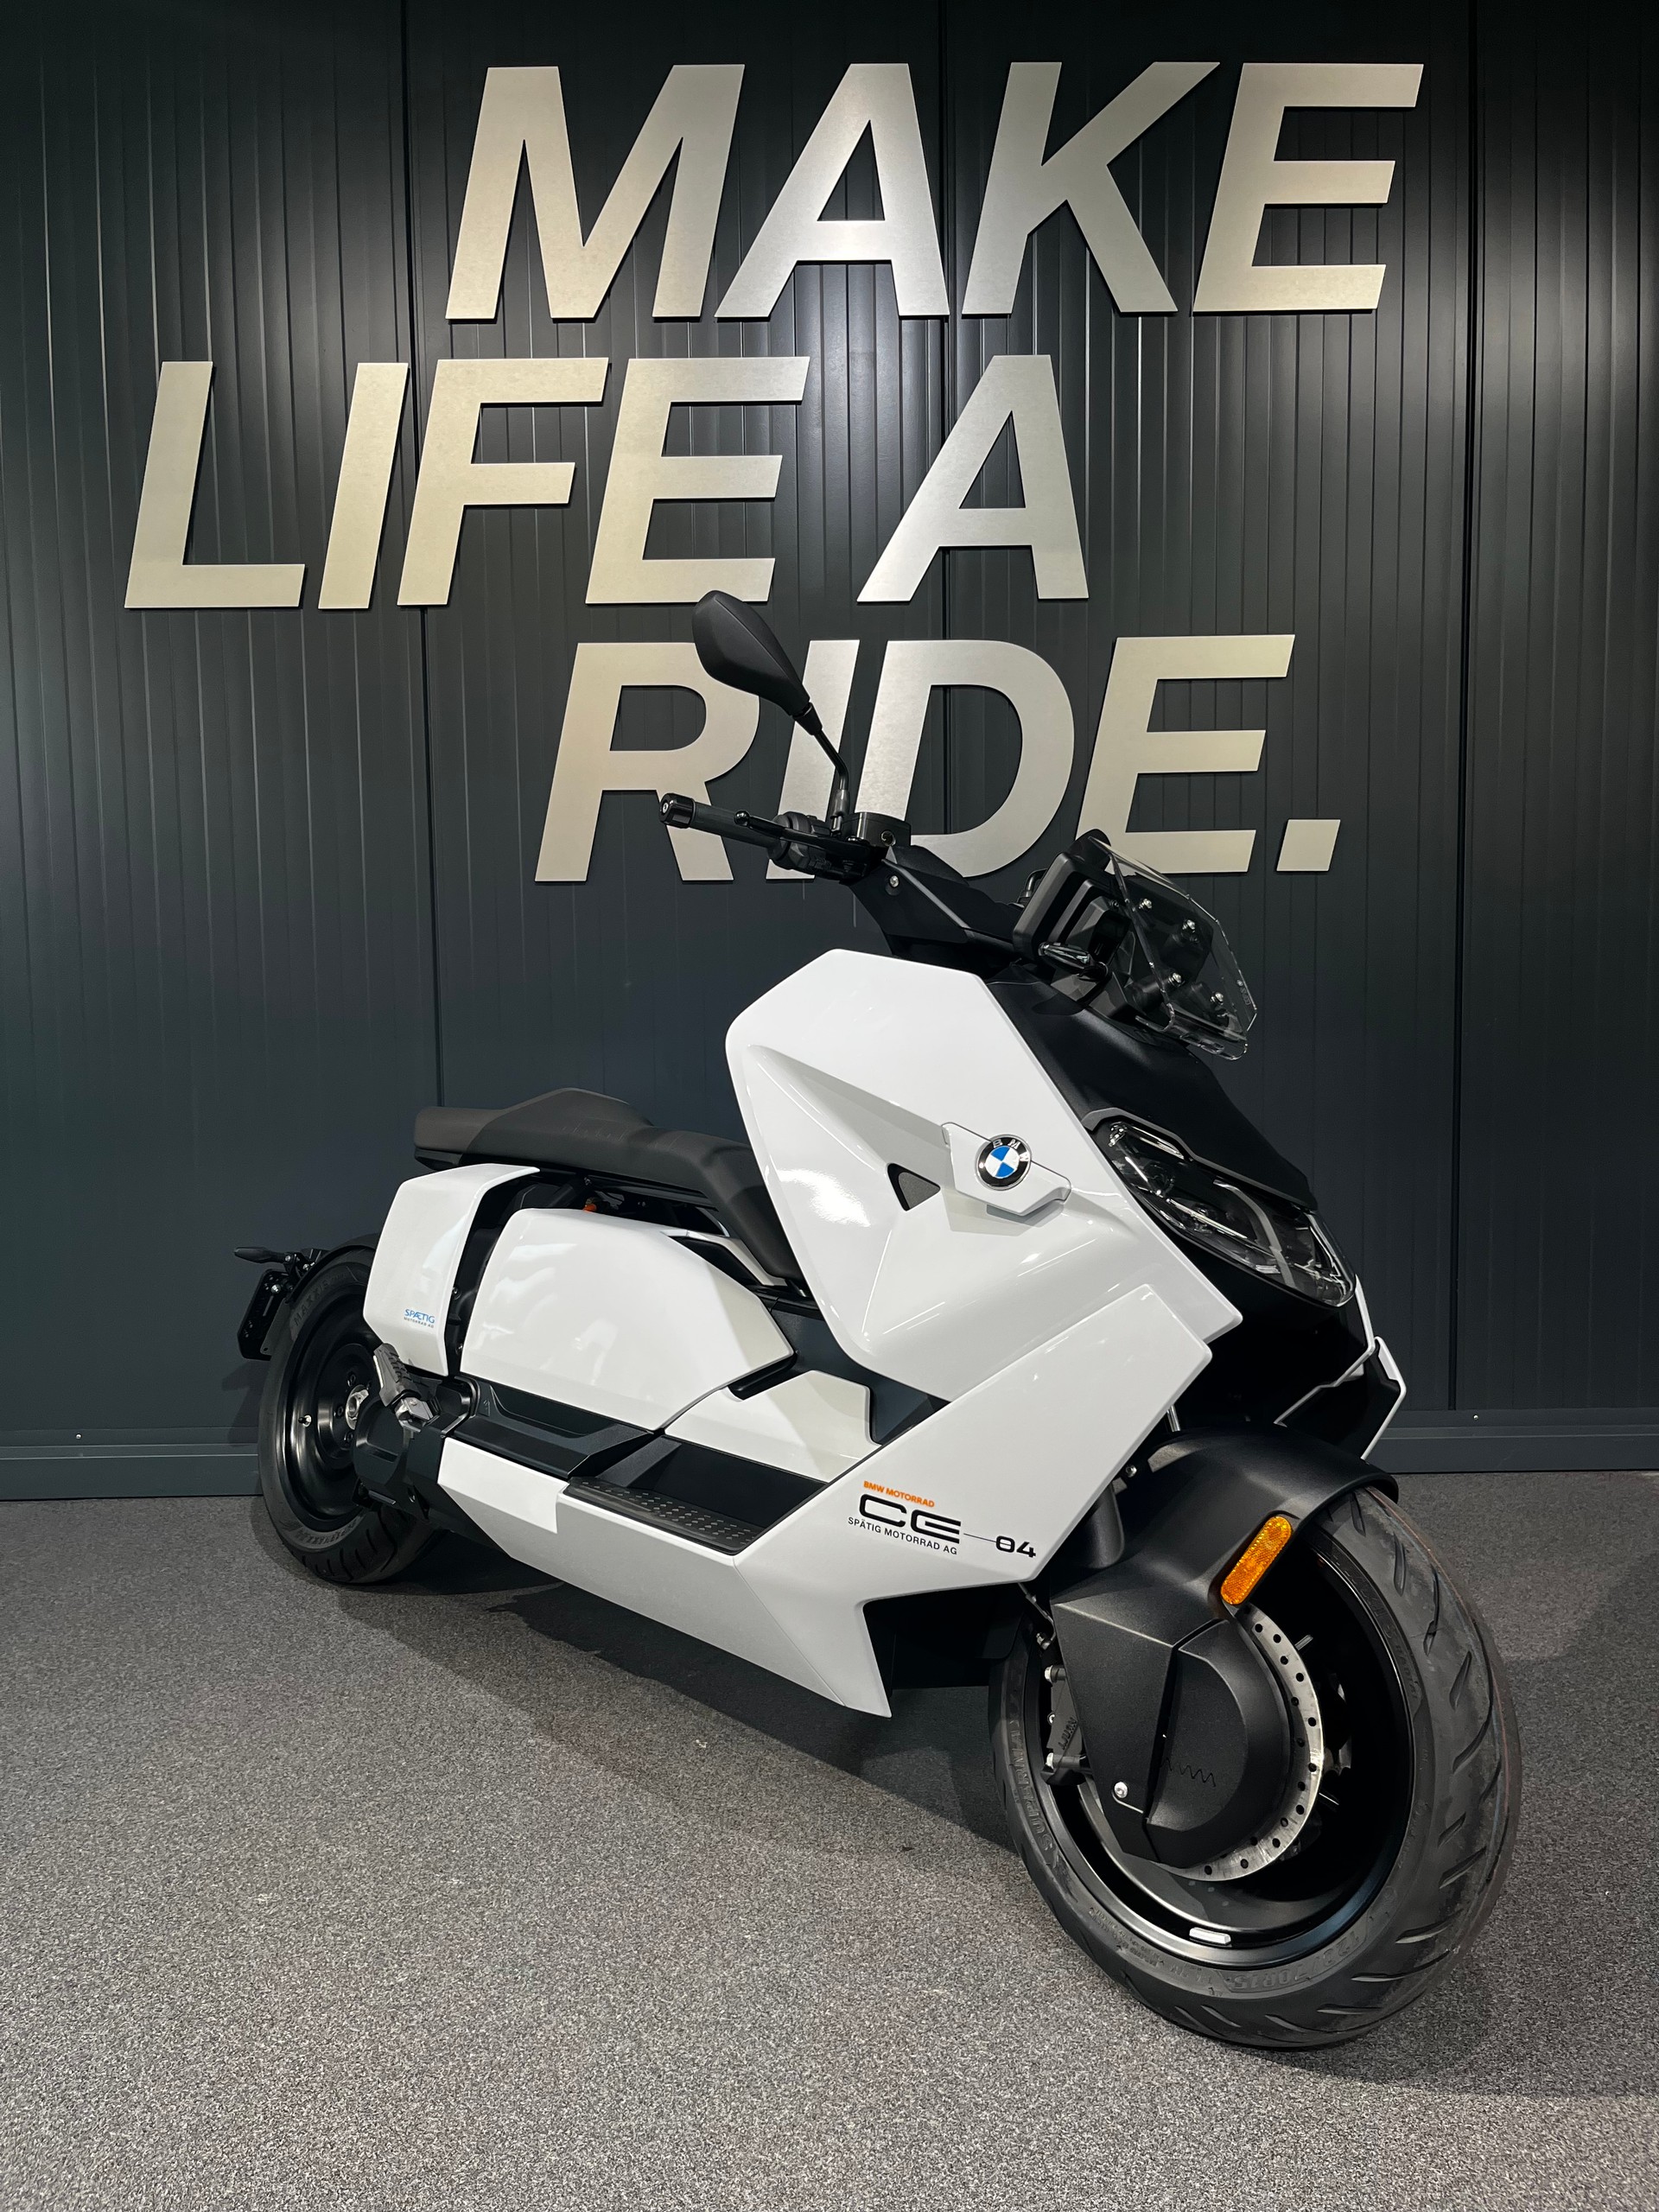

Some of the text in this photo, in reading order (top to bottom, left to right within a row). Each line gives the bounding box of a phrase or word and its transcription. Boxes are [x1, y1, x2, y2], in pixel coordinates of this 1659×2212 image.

[445, 61, 1425, 321] MAKE
[124, 354, 1090, 610] LIFE A
[535, 633, 1341, 883] RIDE.
[848, 1516, 958, 1555] SPÄTIG MOTORRAD AG
[859, 1493, 962, 1545] CE
[863, 1480, 935, 1509] BMW MOTORRAD
